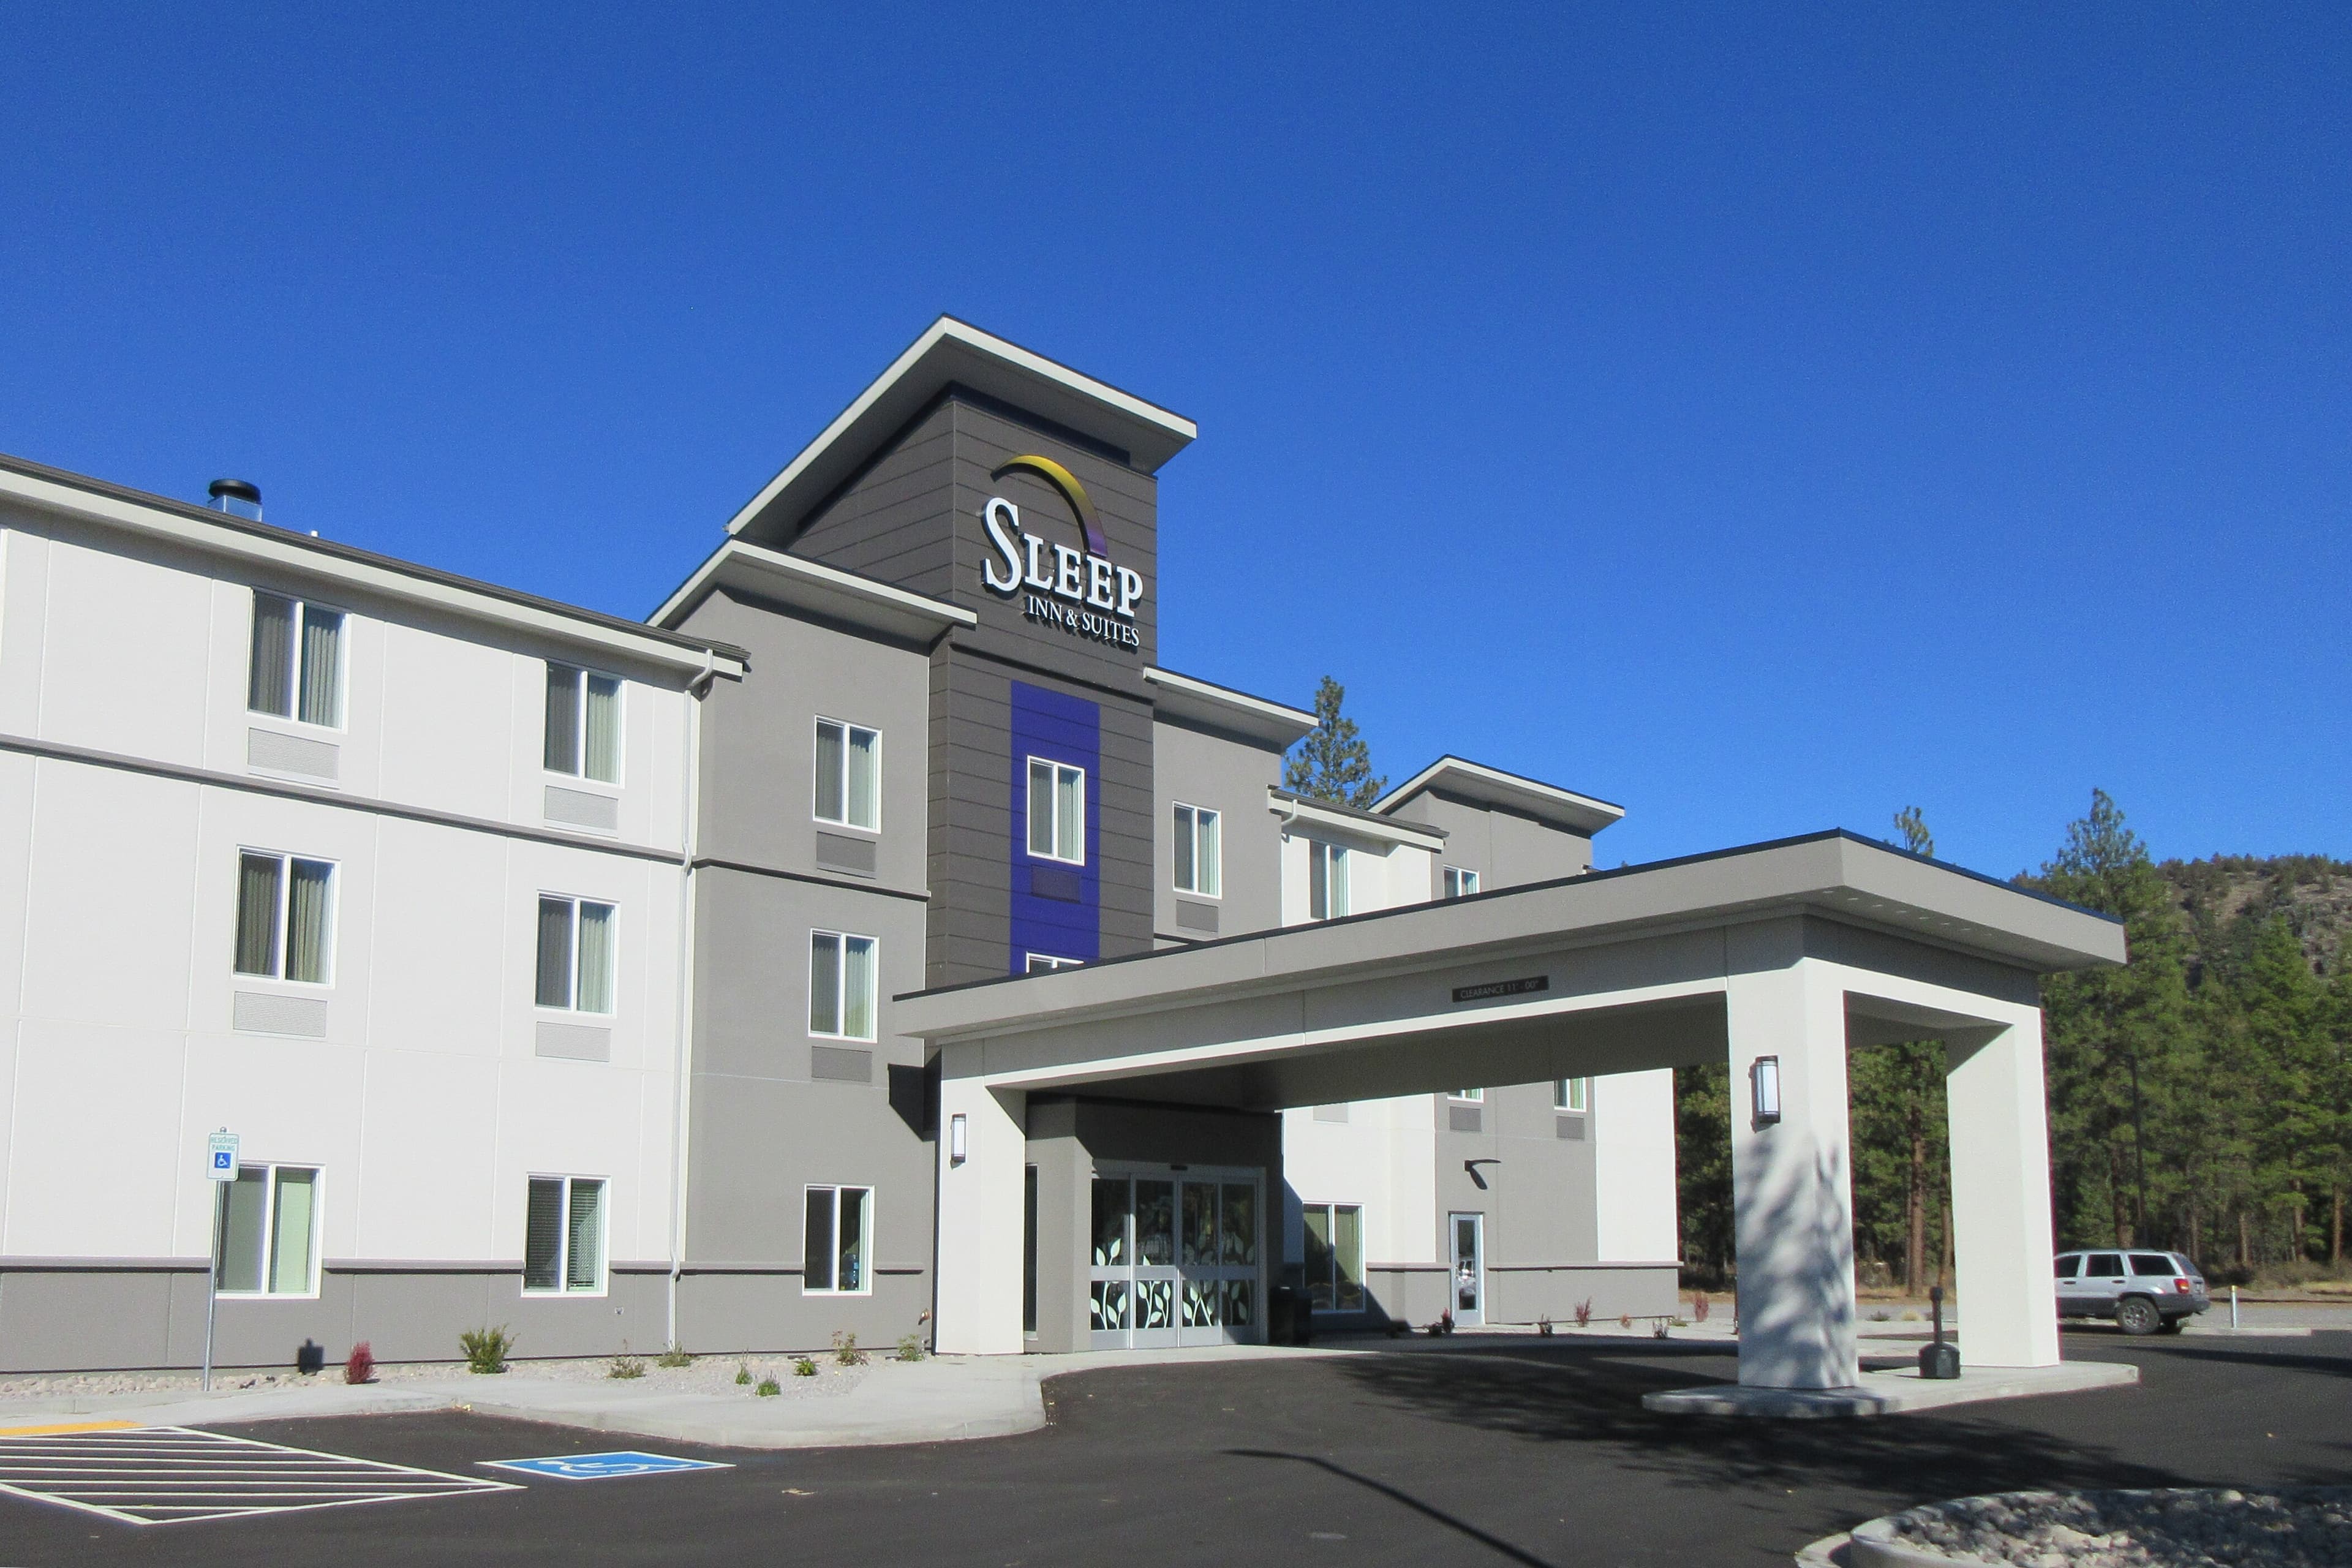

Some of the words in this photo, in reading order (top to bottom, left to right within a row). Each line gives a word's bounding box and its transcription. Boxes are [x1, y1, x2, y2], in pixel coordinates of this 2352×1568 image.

[983, 497, 1143, 617] SLEEP
[1028, 595, 1061, 622] INN
[1066, 609, 1078, 628] &
[1082, 612, 1140, 647] SUITES
[1460, 985, 1504, 998] CLEARANCE
